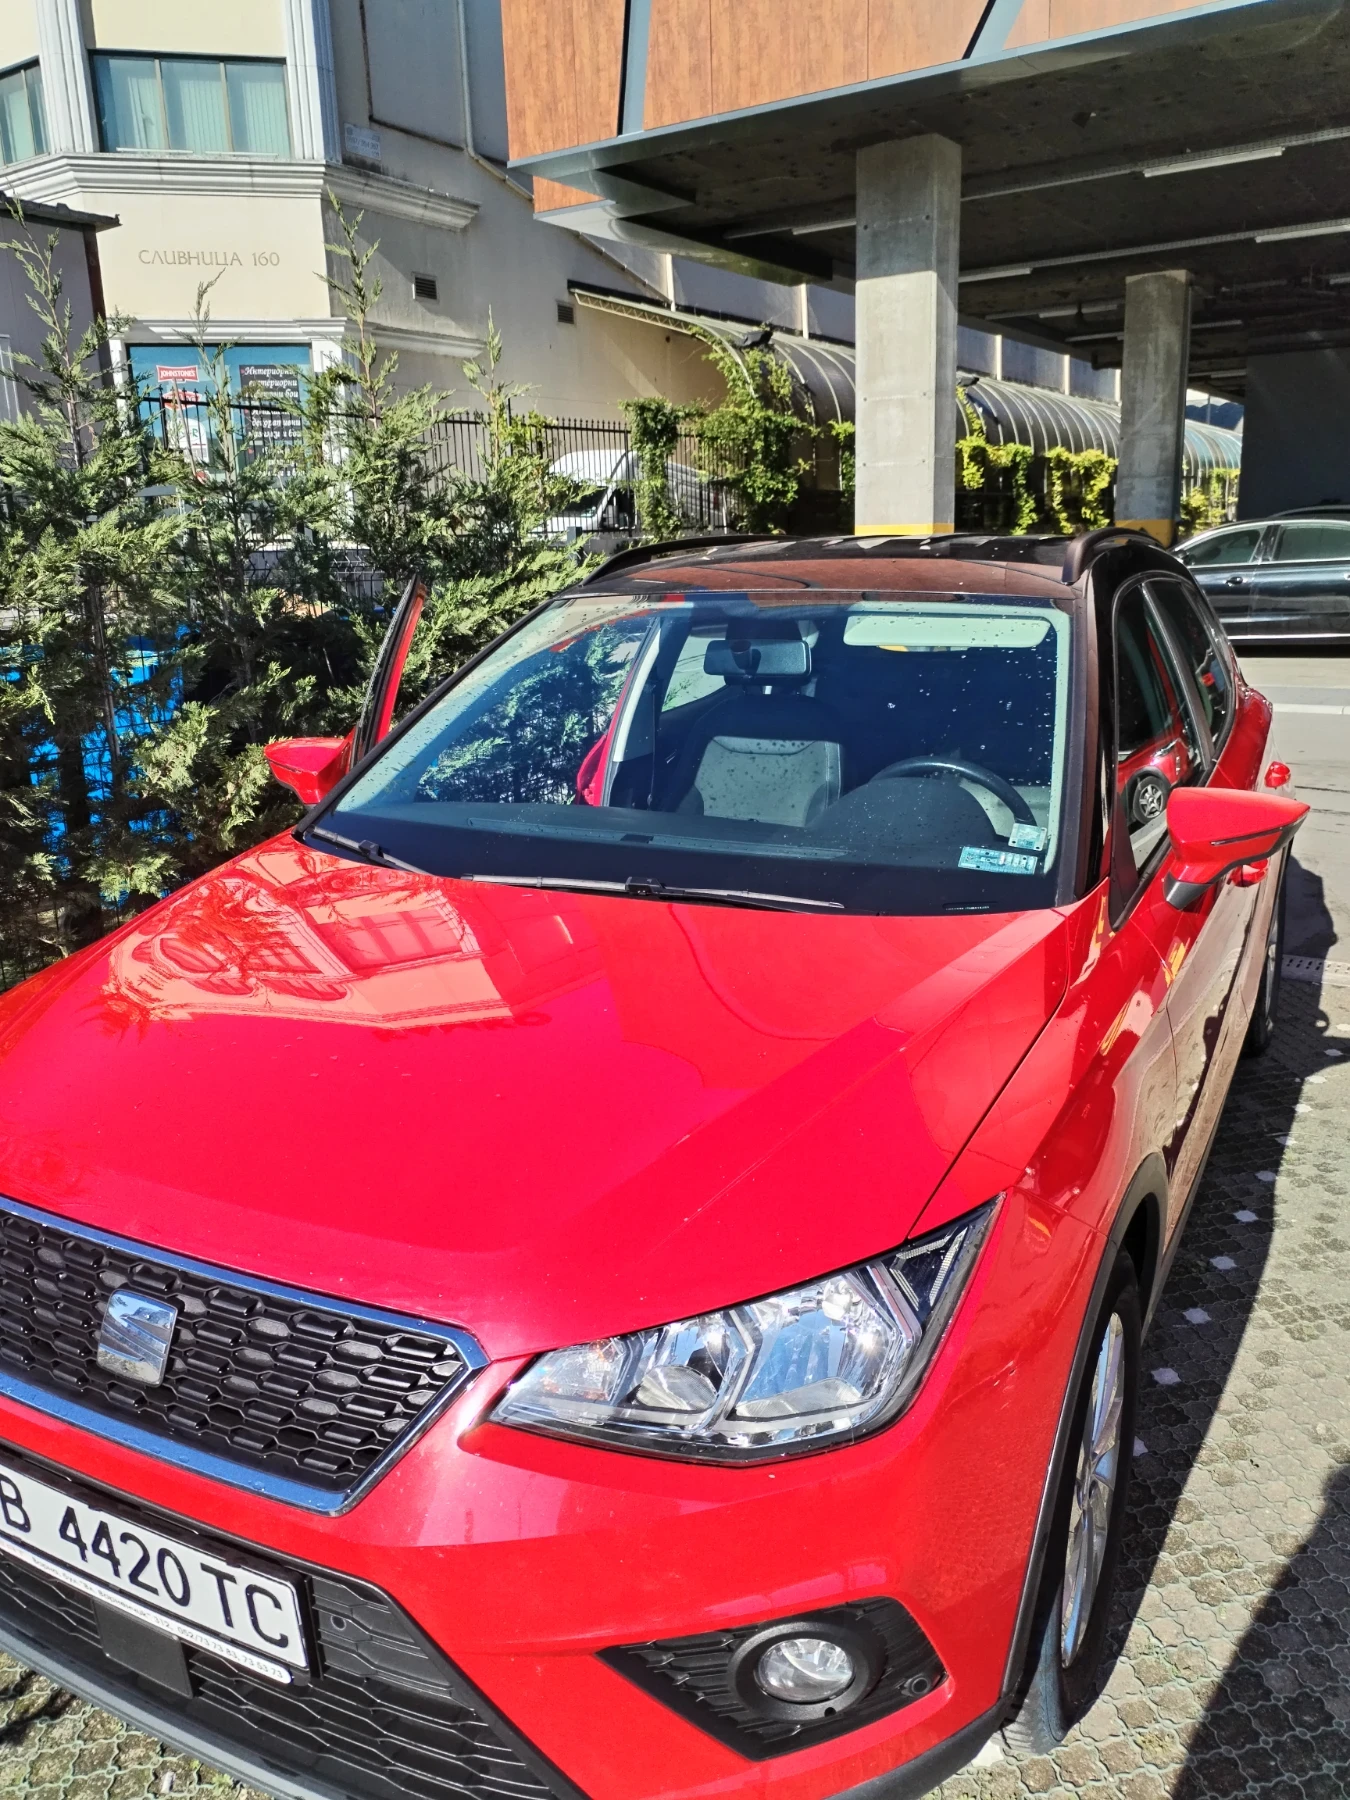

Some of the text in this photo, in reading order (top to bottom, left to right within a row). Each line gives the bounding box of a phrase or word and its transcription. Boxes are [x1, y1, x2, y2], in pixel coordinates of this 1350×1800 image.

[138, 249, 281, 267] СЛИВНИЦА 160
[248, 379, 298, 389] етериорни
[0, 1476, 289, 1649] B 4420 TC
[272, 1667, 283, 1679] 73
